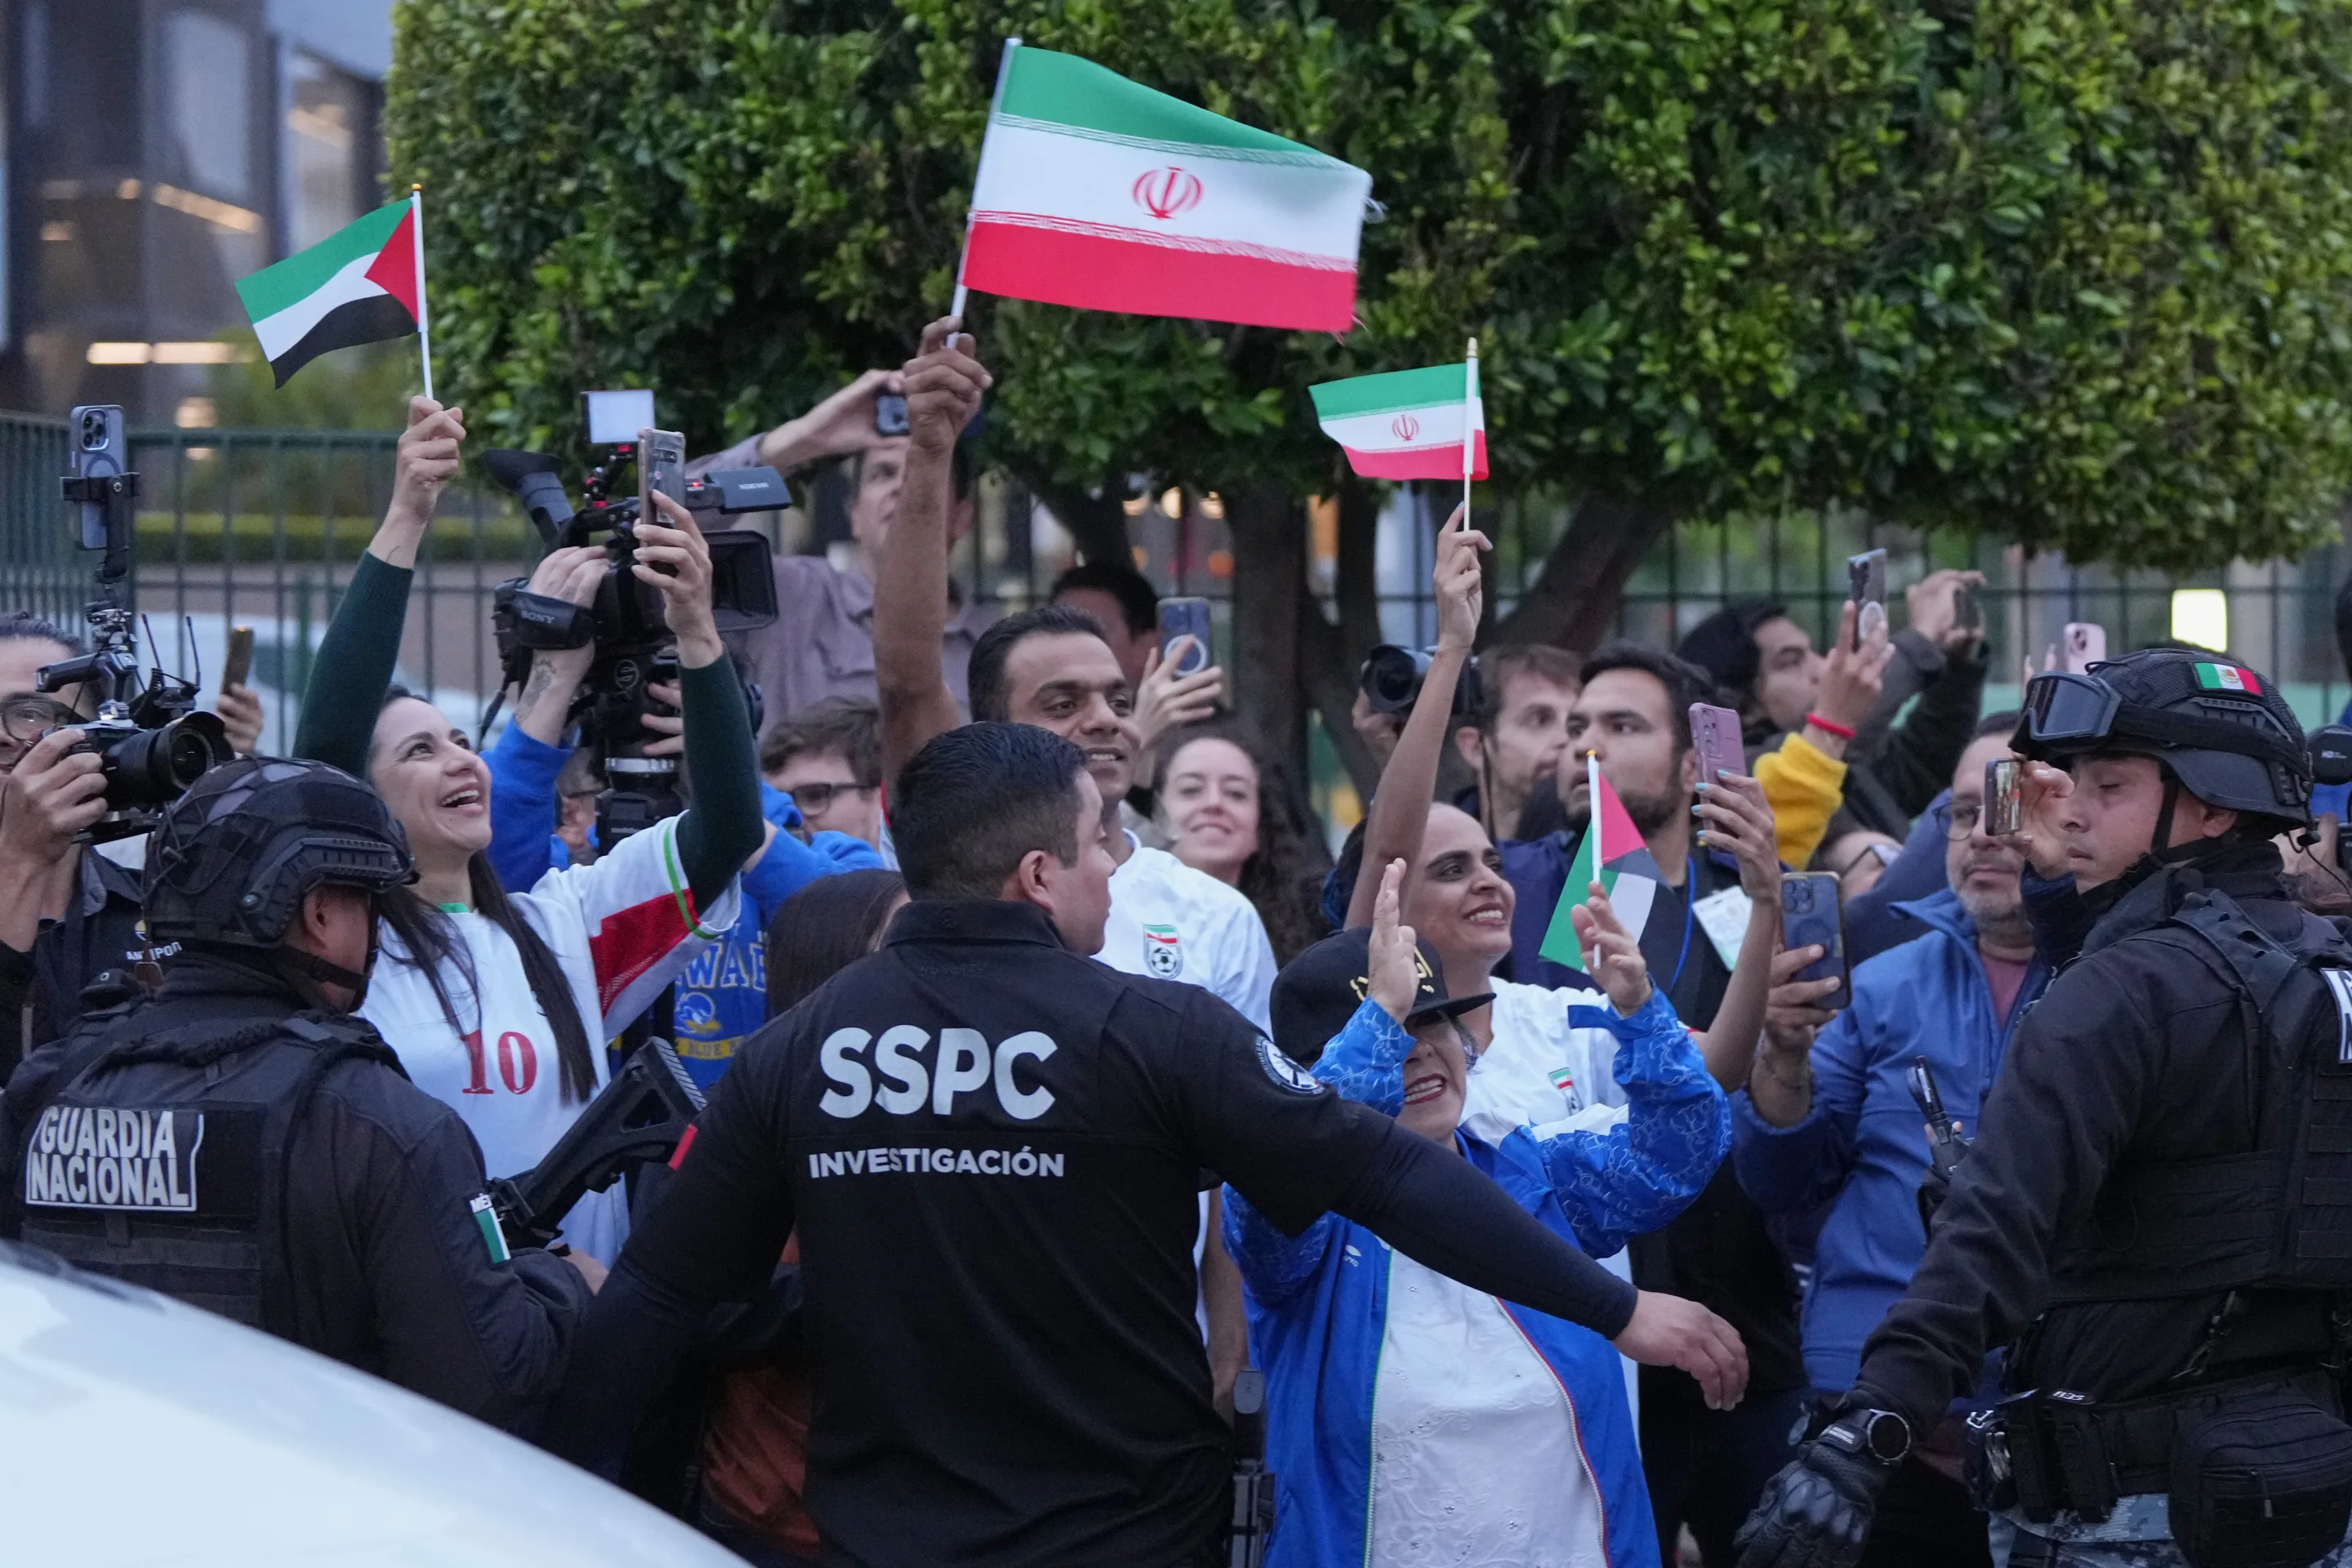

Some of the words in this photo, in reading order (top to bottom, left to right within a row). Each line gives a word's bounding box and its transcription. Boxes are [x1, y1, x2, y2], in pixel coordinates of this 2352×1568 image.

[521, 609, 555, 624] SONY
[460, 1029, 537, 1094] 10
[819, 1024, 1058, 1120] SSPC
[41, 1106, 177, 1159] GUARDIA
[31, 1152, 189, 1207] NACIONAL
[808, 1145, 1065, 1178] INVESTIGACIÓN
